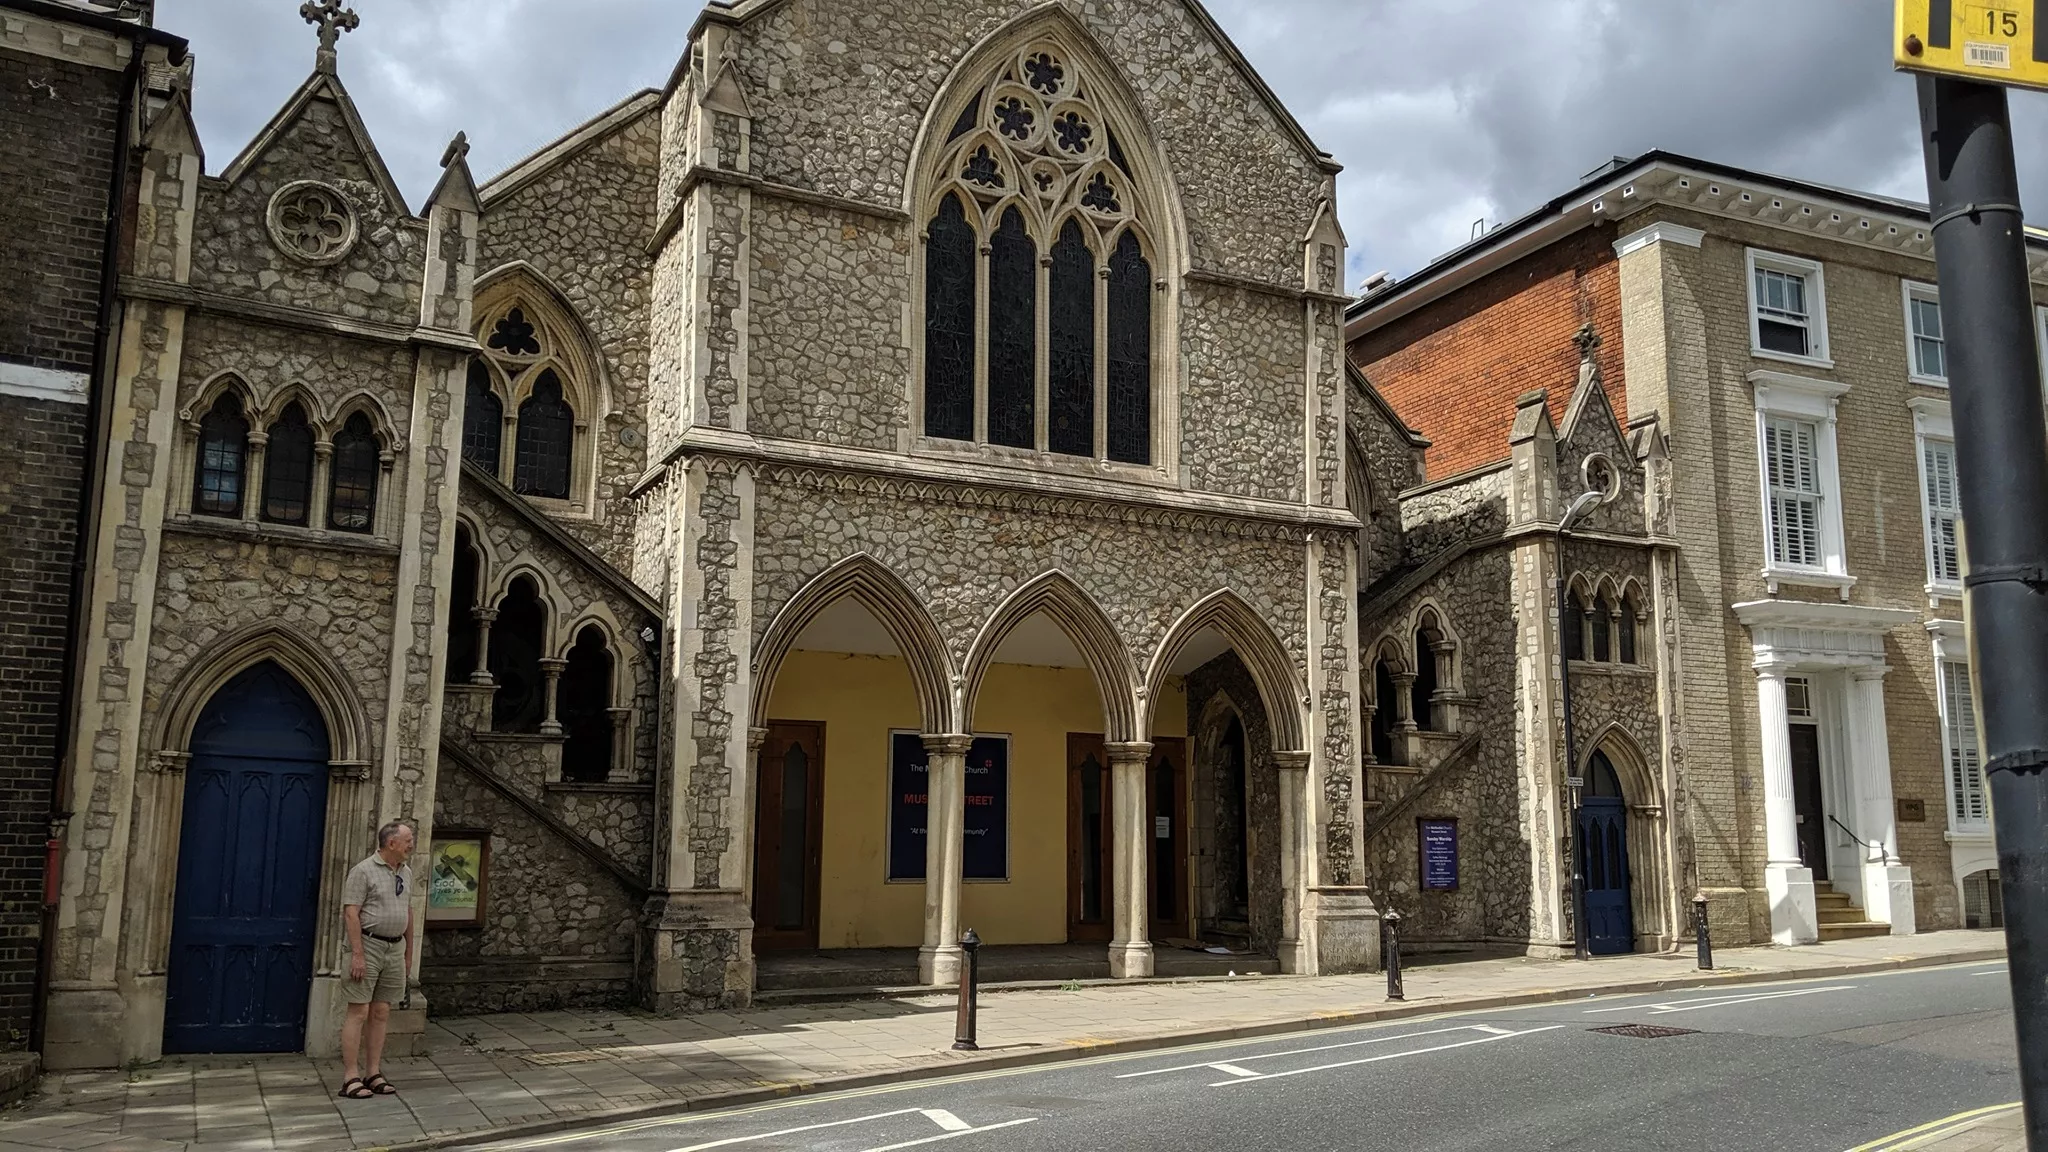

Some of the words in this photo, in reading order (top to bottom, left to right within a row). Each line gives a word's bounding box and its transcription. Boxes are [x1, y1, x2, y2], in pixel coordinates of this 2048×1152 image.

[1986, 11, 2017, 37] 15
[910, 763, 924, 773] The
[964, 765, 989, 775] Church
[904, 794, 928, 805] MUS
[964, 795, 994, 806] TREET
[434, 878, 455, 887] God
